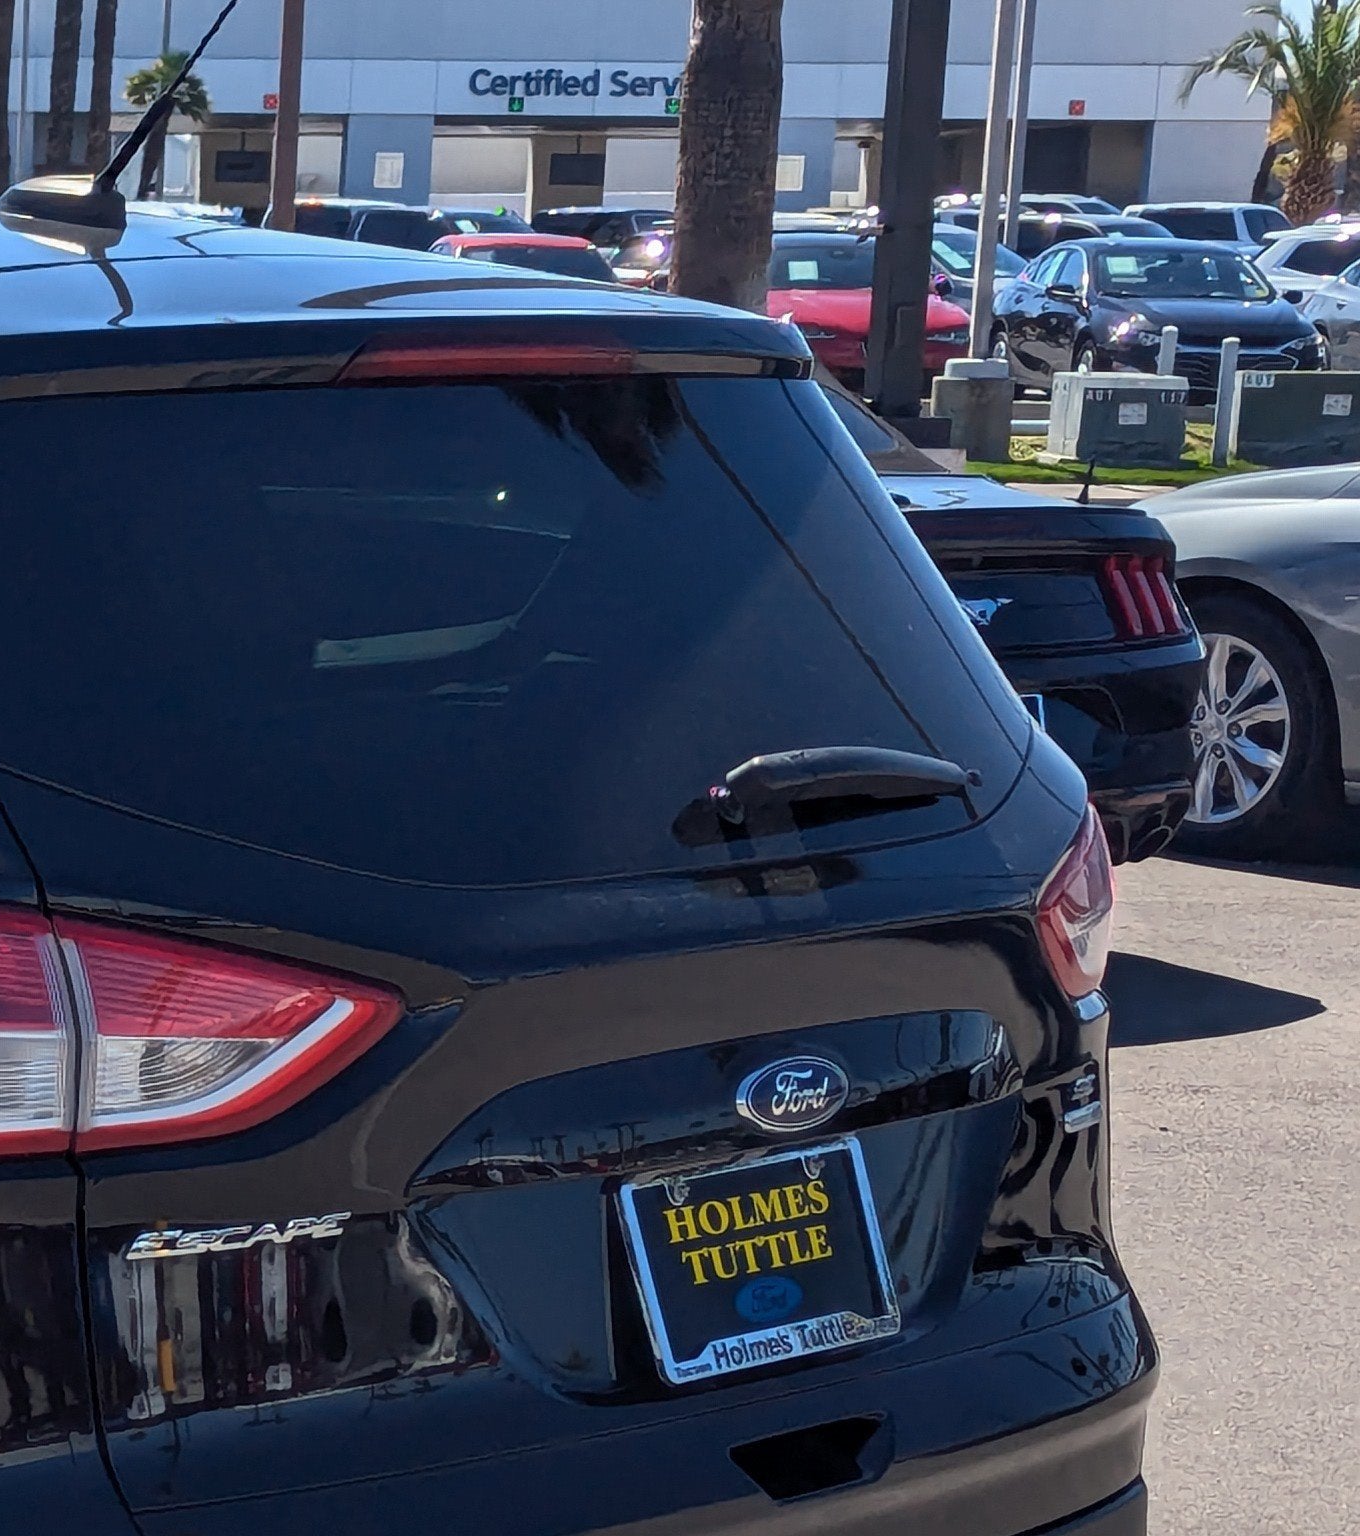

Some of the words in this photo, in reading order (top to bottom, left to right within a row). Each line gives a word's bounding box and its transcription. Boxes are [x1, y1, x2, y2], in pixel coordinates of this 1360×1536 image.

[469, 68, 600, 97] Certified
[610, 69, 681, 97] Serv
[771, 1068, 830, 1116] Ford
[126, 1211, 352, 1260] ESCAPE
[662, 1180, 830, 1244] HOLMES
[681, 1224, 833, 1285] TUTTLE
